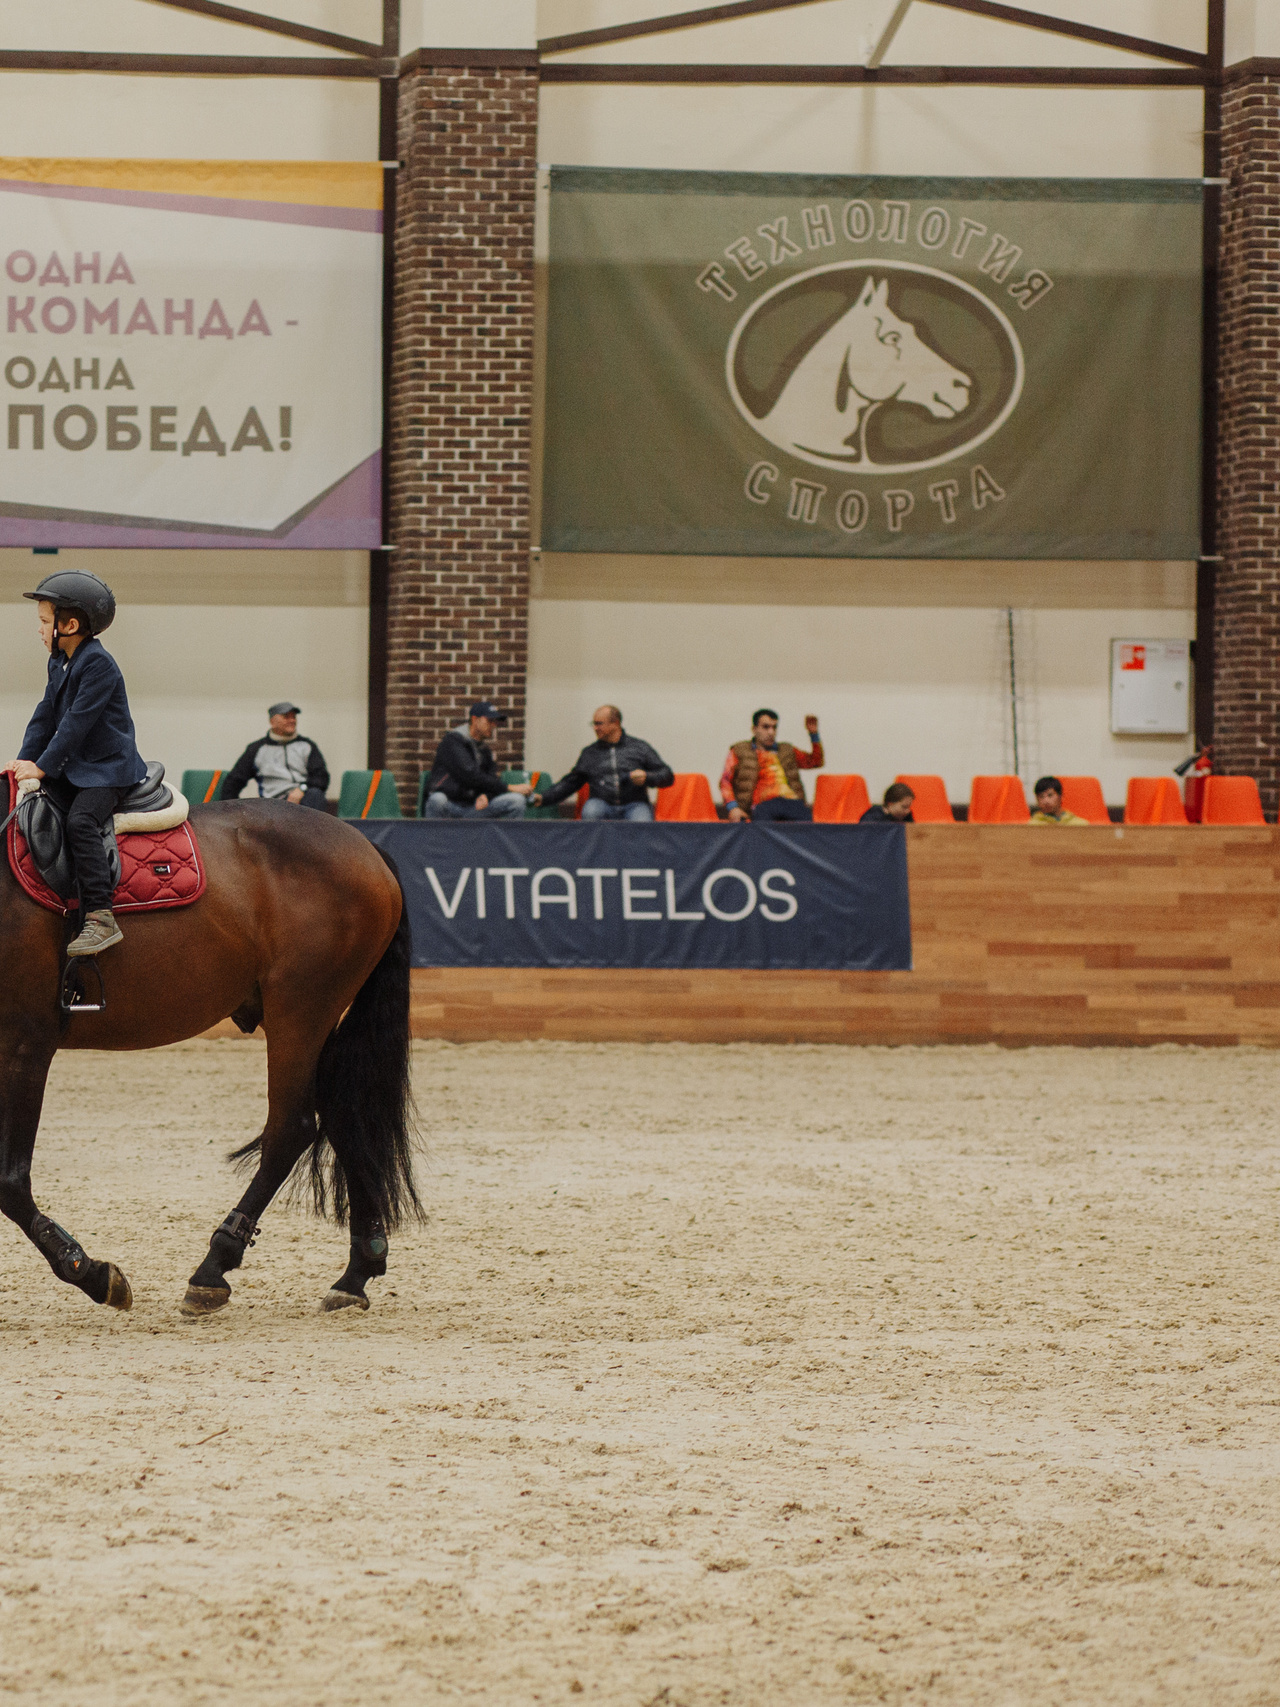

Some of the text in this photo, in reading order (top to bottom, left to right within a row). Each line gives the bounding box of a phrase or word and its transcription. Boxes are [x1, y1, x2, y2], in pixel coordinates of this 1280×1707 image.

[4, 249, 136, 288] ОДНА
[697, 200, 1054, 310] ТЕХНОЛОГИЯ
[6, 296, 272, 340] КОМАНДА
[4, 356, 136, 393] ОДНА
[7, 403, 294, 457] ПОБЕДА!
[744, 461, 1007, 533] СПОРТА
[425, 867, 798, 922] VITATELOS
